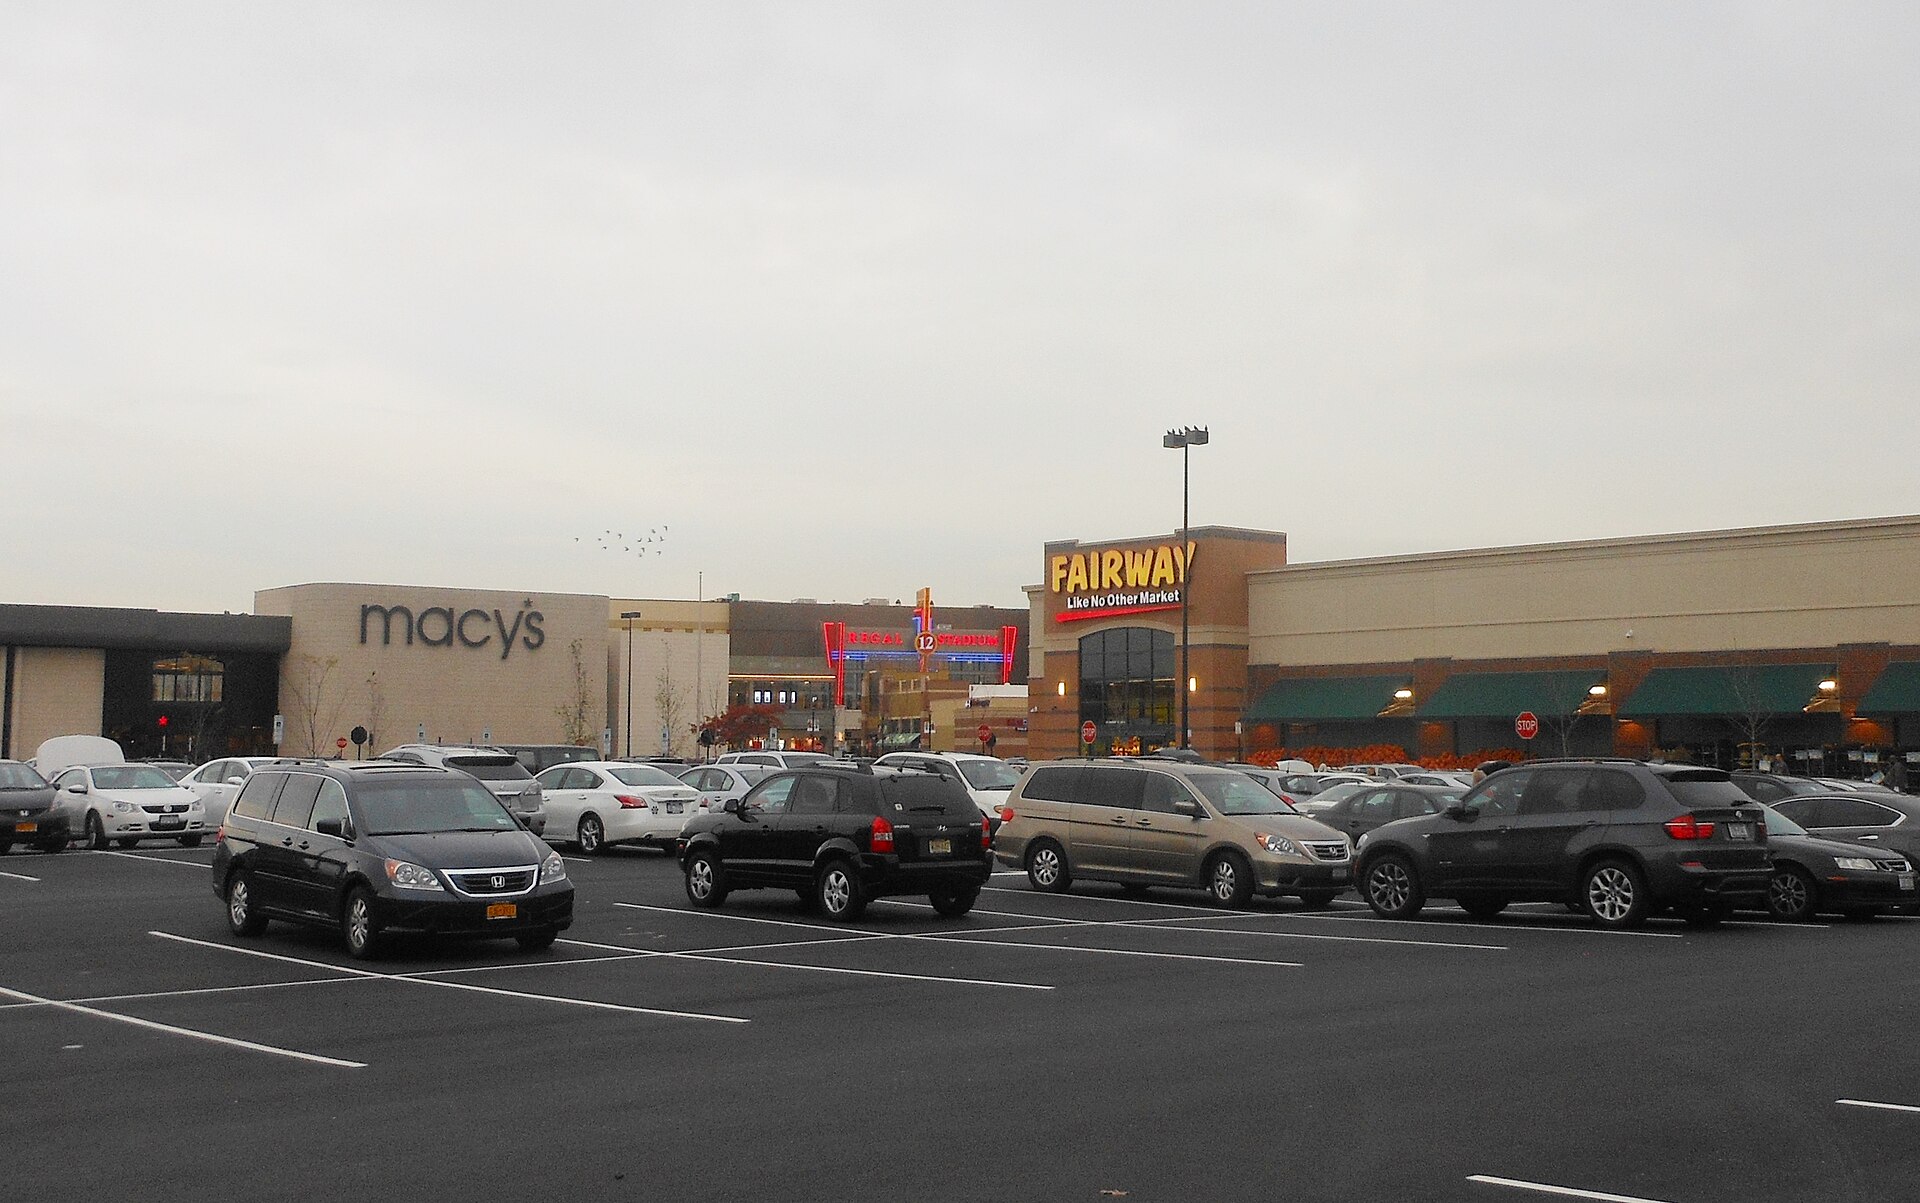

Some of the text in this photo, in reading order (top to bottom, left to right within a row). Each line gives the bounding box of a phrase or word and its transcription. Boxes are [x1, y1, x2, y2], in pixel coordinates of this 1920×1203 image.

[1052, 541, 1197, 593] FAIRWAY
[1067, 589, 1180, 609] Like No Other Market
[848, 631, 999, 650] REGAL 12 STADIUM
[1517, 720, 1536, 731] STOP
